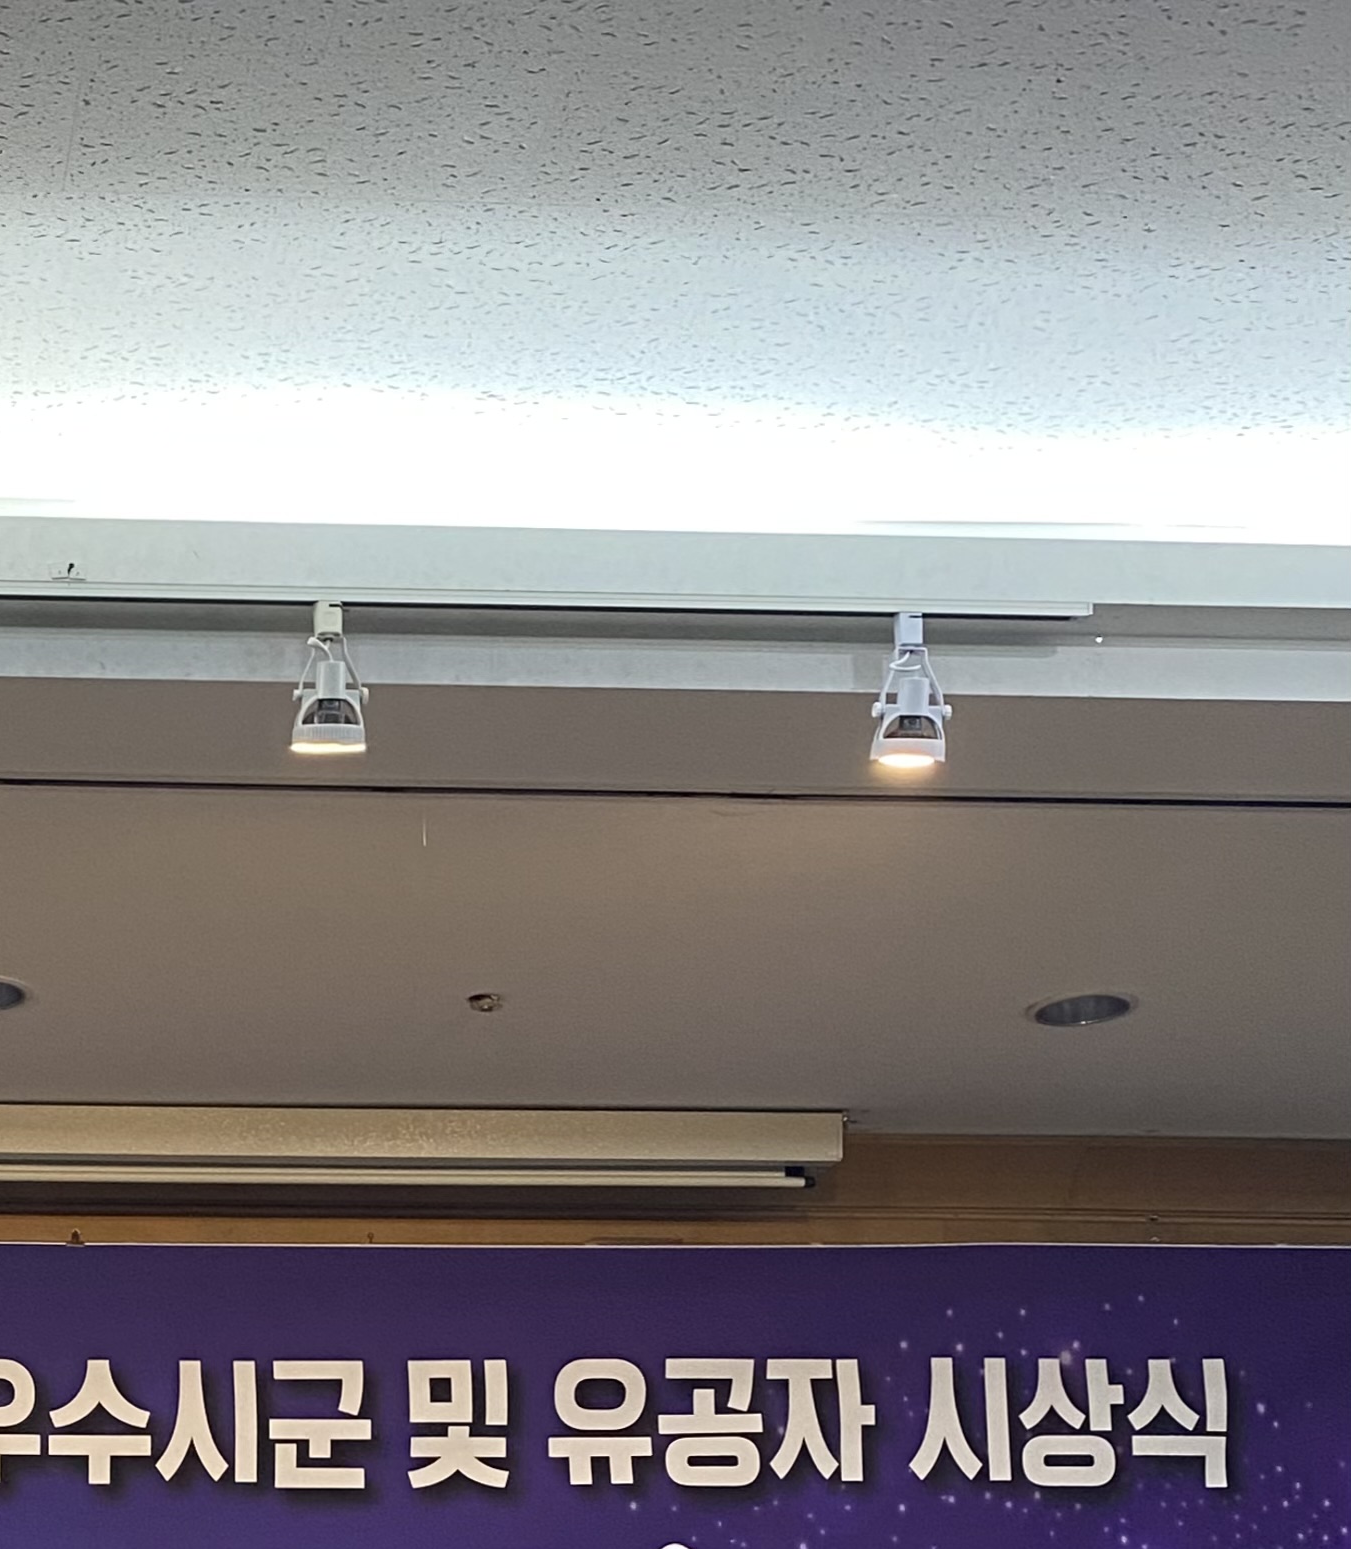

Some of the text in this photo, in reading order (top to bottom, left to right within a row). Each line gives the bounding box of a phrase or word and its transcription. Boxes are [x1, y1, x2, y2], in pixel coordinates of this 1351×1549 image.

[407, 1359, 510, 1489] 및
[547, 1358, 876, 1487] 유공자
[908, 1357, 1228, 1488] 시상식
